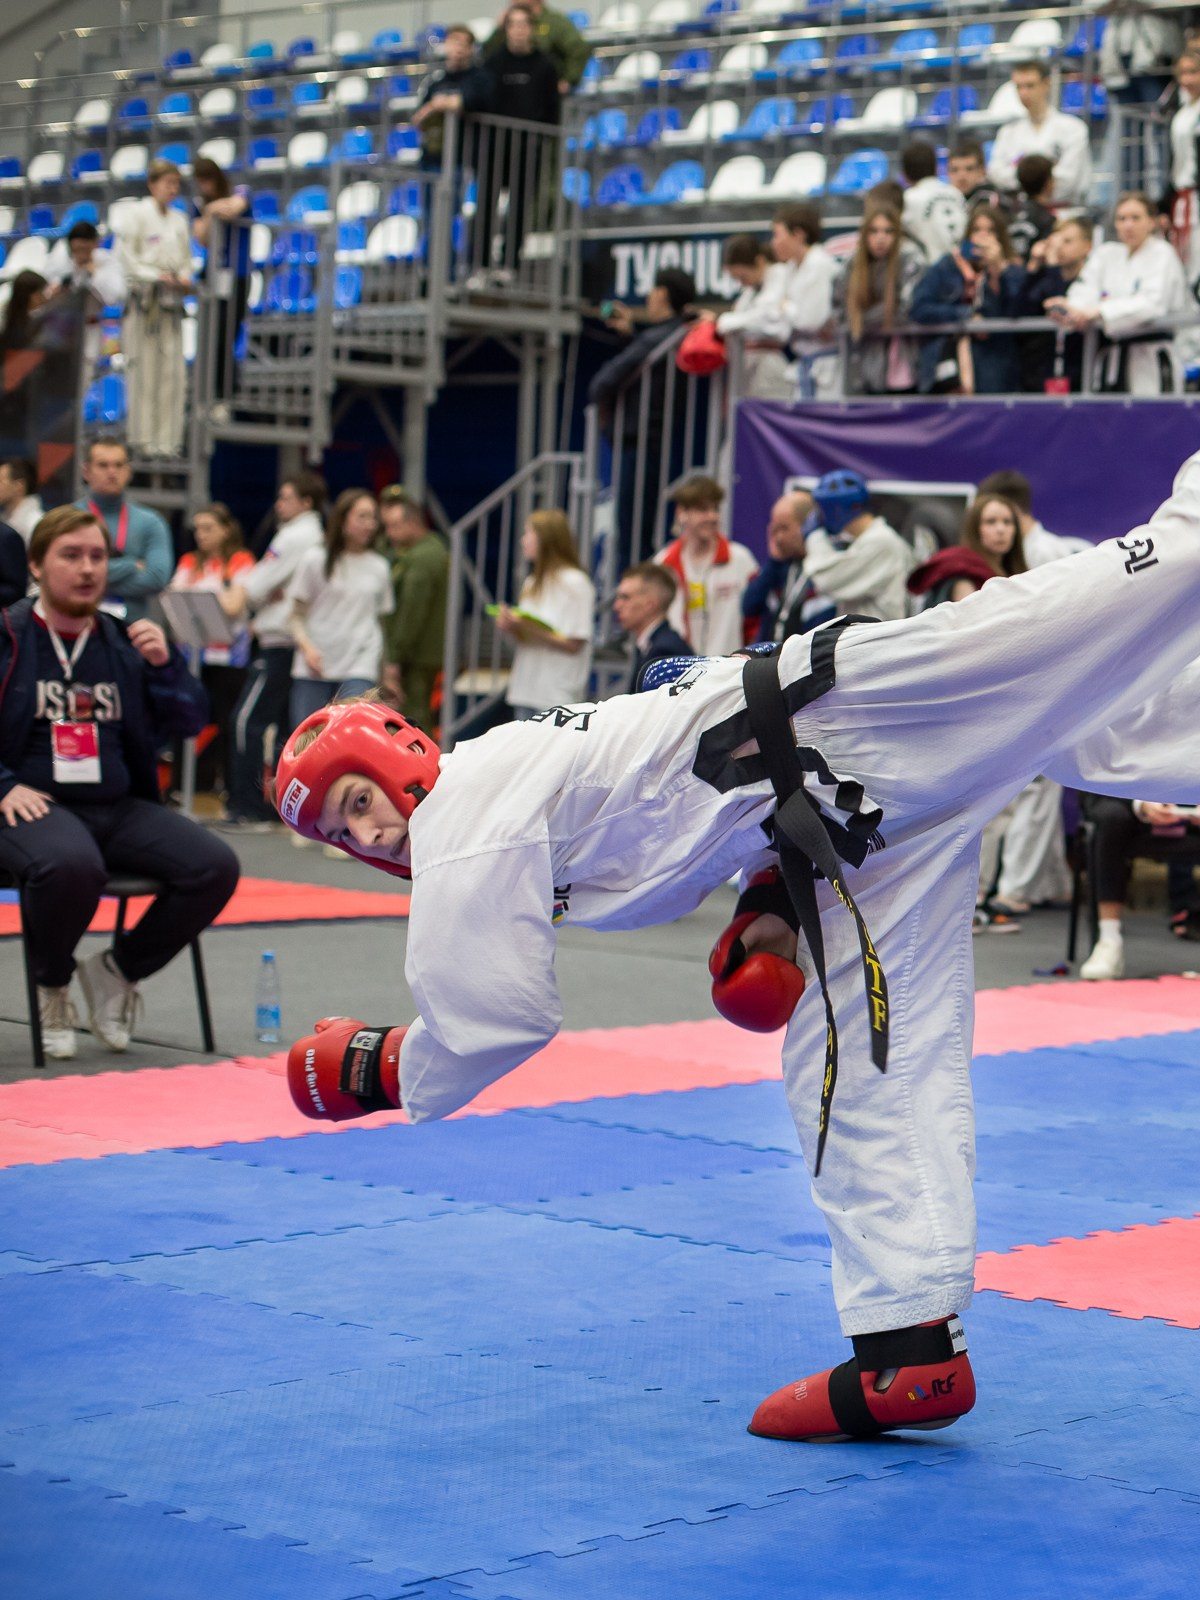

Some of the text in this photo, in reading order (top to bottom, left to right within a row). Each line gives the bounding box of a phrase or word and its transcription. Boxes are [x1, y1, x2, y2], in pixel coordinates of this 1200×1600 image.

[289, 784, 304, 804] TEN
[305, 1048, 326, 1112] MAX PRO
